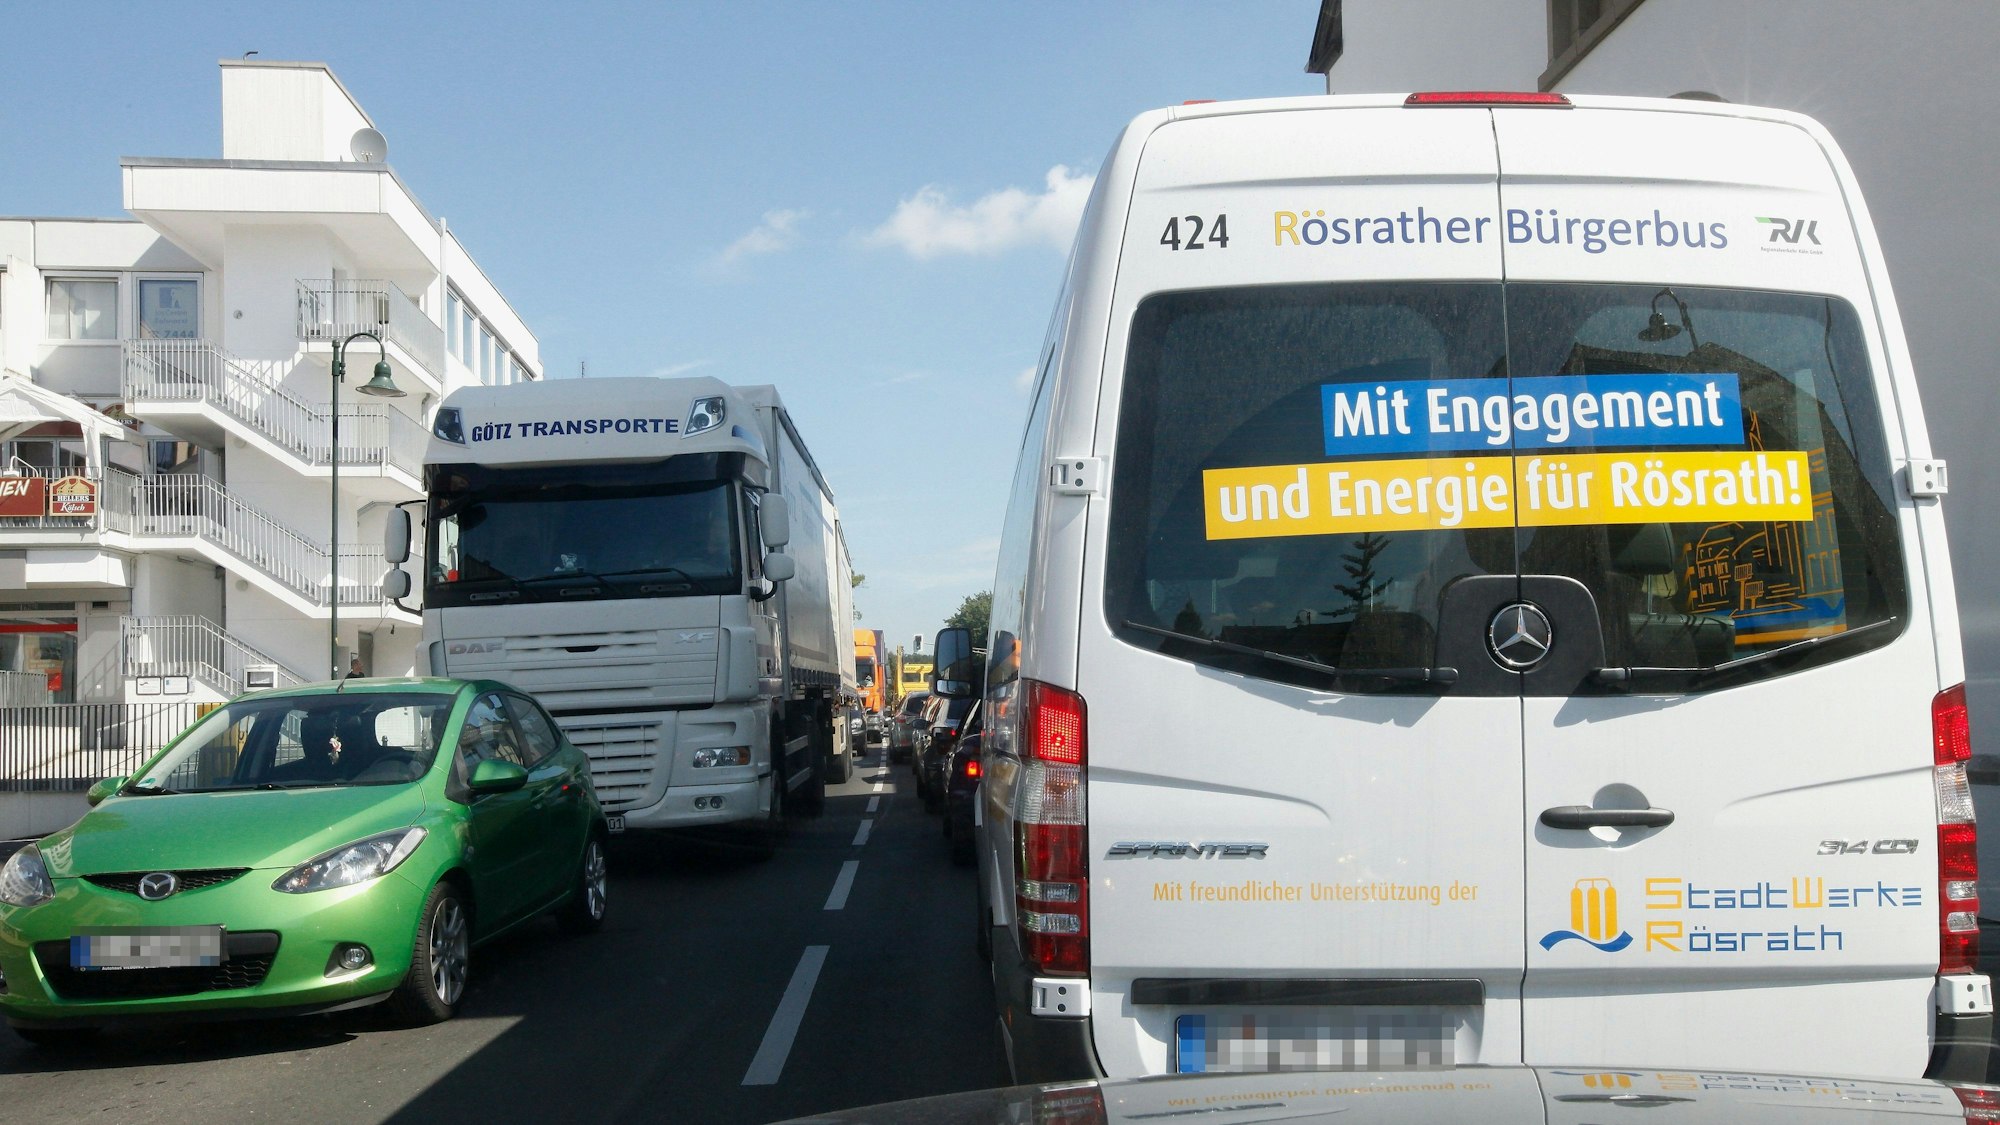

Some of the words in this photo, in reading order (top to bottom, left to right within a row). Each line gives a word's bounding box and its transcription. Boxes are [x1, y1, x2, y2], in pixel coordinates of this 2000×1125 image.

[1160, 213, 1230, 251] 424
[1274, 206, 1491, 246] Rösrather
[1506, 208, 1729, 254] Bürgerbus
[1334, 386, 1411, 437] Mit
[1426, 381, 1724, 446] Engagement
[471, 422, 512, 442] GÖTZ
[517, 418, 679, 438] TRANSPORTE
[1219, 467, 1310, 523] und
[1328, 462, 1508, 526] Energie
[1525, 458, 1593, 510] für
[1610, 454, 1802, 507] Rösrath!
[60, 502, 86, 513] Kölsch
[449, 643, 503, 655] DAF
[675, 631, 715, 644] XF
[1108, 841, 1270, 857] SPRINTER
[1817, 839, 1869, 856] 314
[1871, 839, 1919, 855] CDI
[1153, 882, 1183, 901] Mit
[1189, 880, 1303, 901] freundlicher
[1310, 882, 1440, 906] Unterstützung
[1448, 880, 1478, 901] der
[1645, 876, 1922, 910] StadtWerke
[1645, 920, 1842, 952] Rösrath
